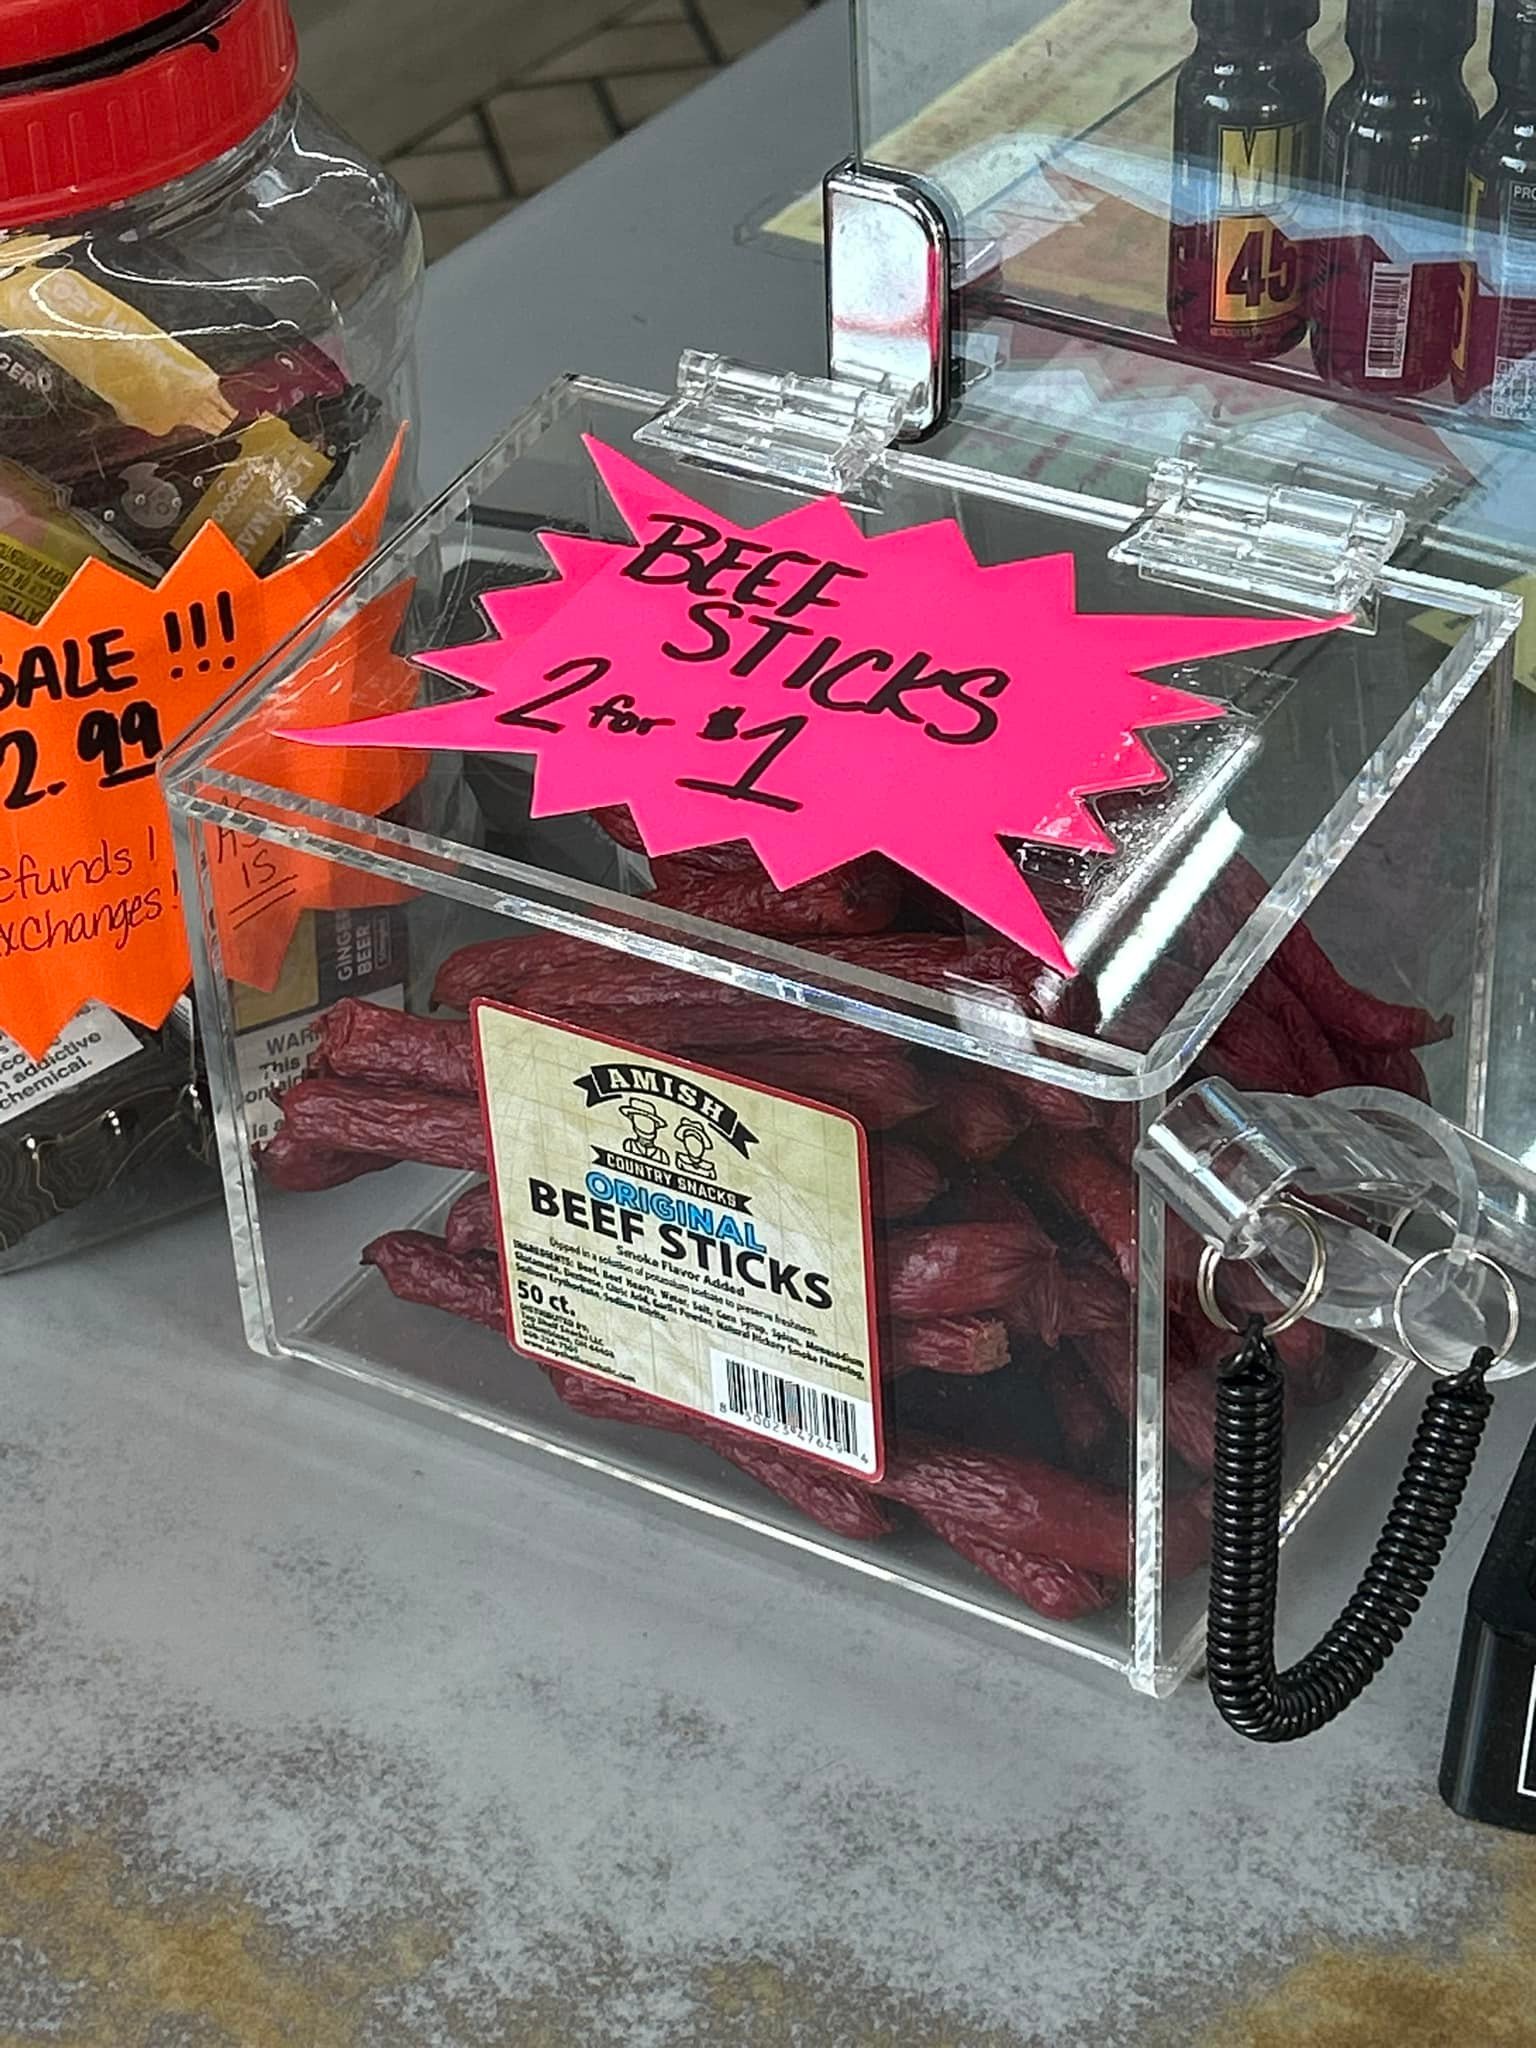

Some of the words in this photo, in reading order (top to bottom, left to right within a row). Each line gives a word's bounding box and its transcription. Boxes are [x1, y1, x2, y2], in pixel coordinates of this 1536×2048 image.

[1226, 230, 1297, 308] 45
[620, 513, 868, 617] BEEF
[494, 657, 612, 734] 2
[588, 694, 676, 736] for
[661, 601, 1011, 745] STICKS
[355, 922, 373, 976] BEER
[0, 1055, 93, 1111] chemical.
[12, 1032, 102, 1084] addictive
[609, 1067, 726, 1124] AMISH
[605, 1152, 673, 1189] COUNTRY
[676, 1176, 737, 1209] SNACKS
[585, 1170, 768, 1253] ORIGINAL
[529, 1177, 645, 1245] BEEF
[658, 1223, 834, 1310] STICKS
[616, 1244, 660, 1268] Smoke
[661, 1260, 701, 1283] Flavor
[703, 1275, 746, 1297] Added
[517, 1279, 543, 1305] 50
[549, 1294, 576, 1317] ct.
